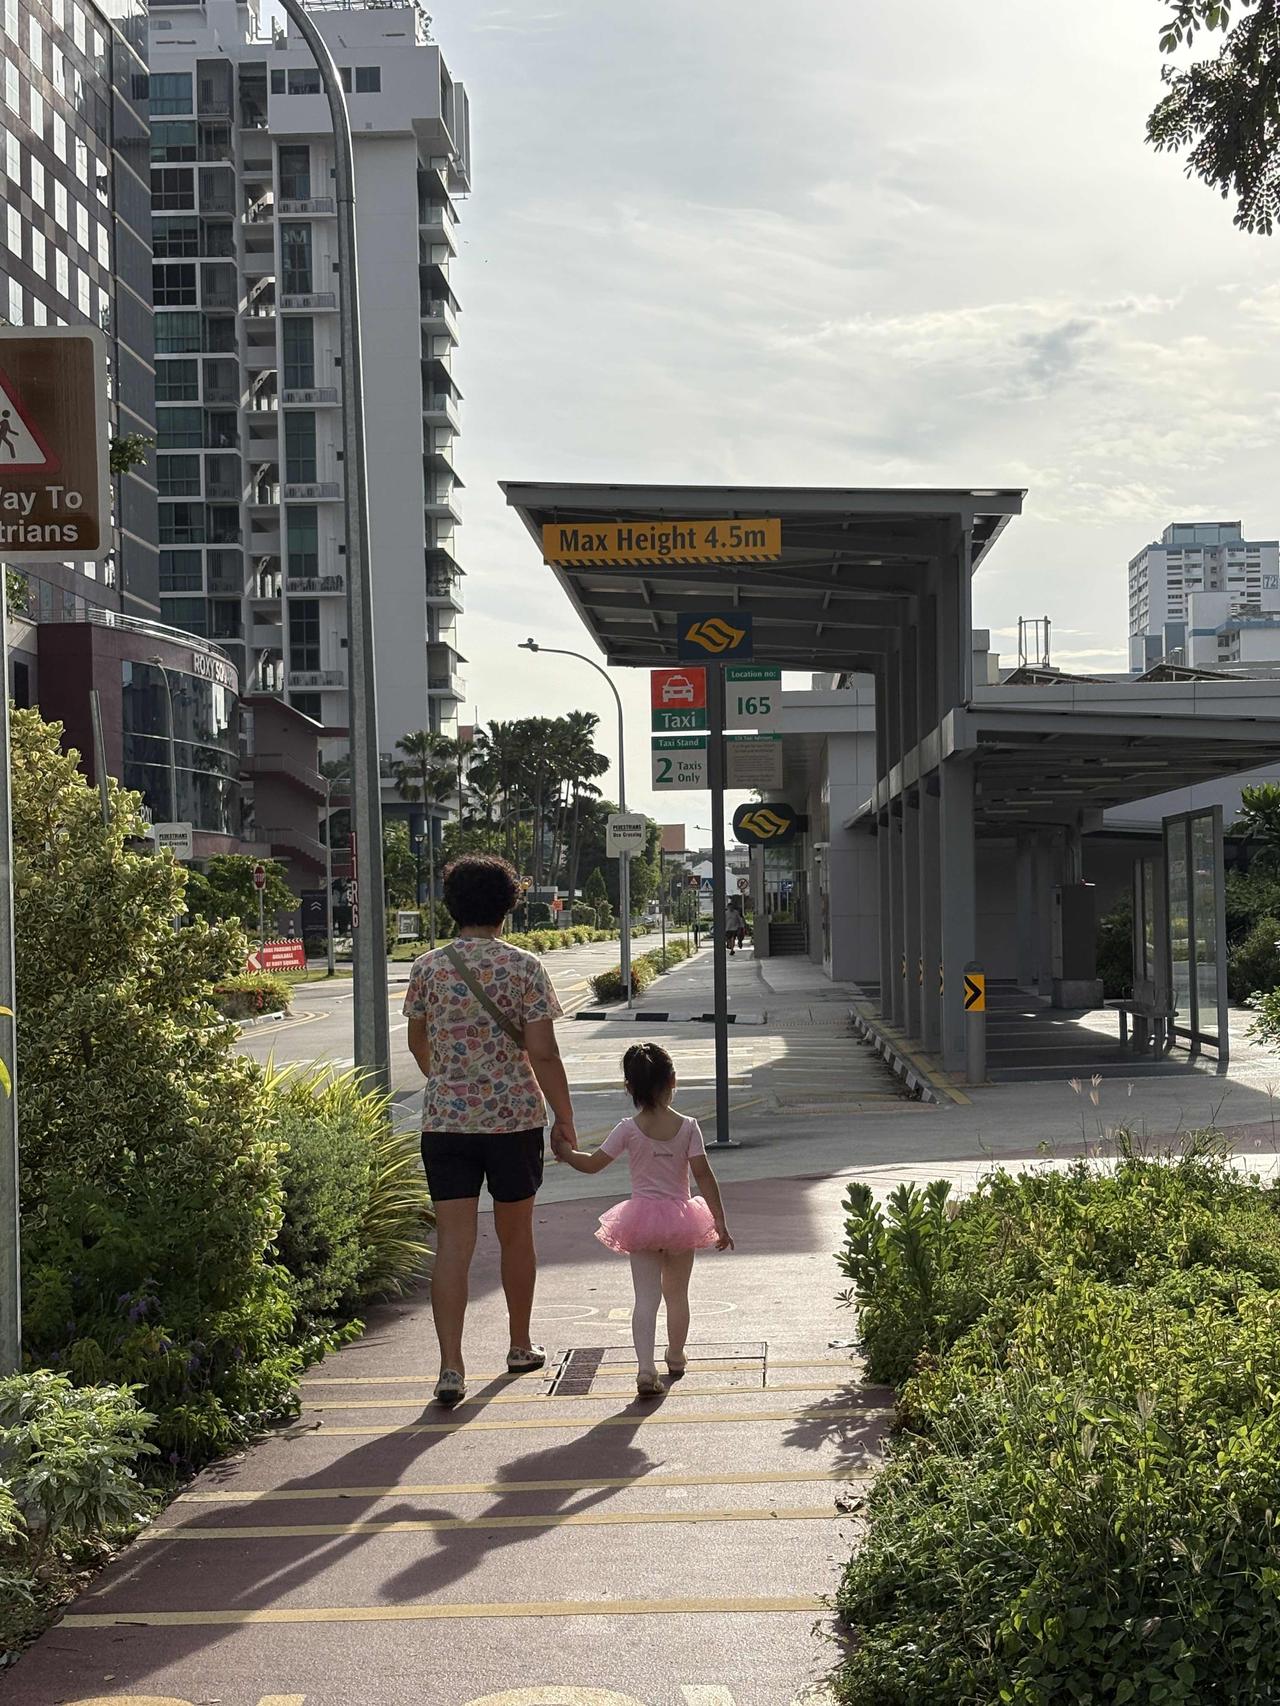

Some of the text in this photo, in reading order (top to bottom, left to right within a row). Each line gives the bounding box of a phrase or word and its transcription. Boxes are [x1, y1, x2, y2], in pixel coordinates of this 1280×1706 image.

[0, 486, 83, 516] ay To
[559, 525, 766, 556] Max Height 4.5m
[194, 653, 215, 680] ROXY
[731, 670, 776, 679] Location no:
[738, 696, 771, 715] 165
[661, 711, 696, 729] Taxi
[659, 738, 699, 747] Taxi Stand
[655, 757, 673, 783] 2
[677, 761, 702, 771] Taxis
[678, 773, 700, 784] Only
